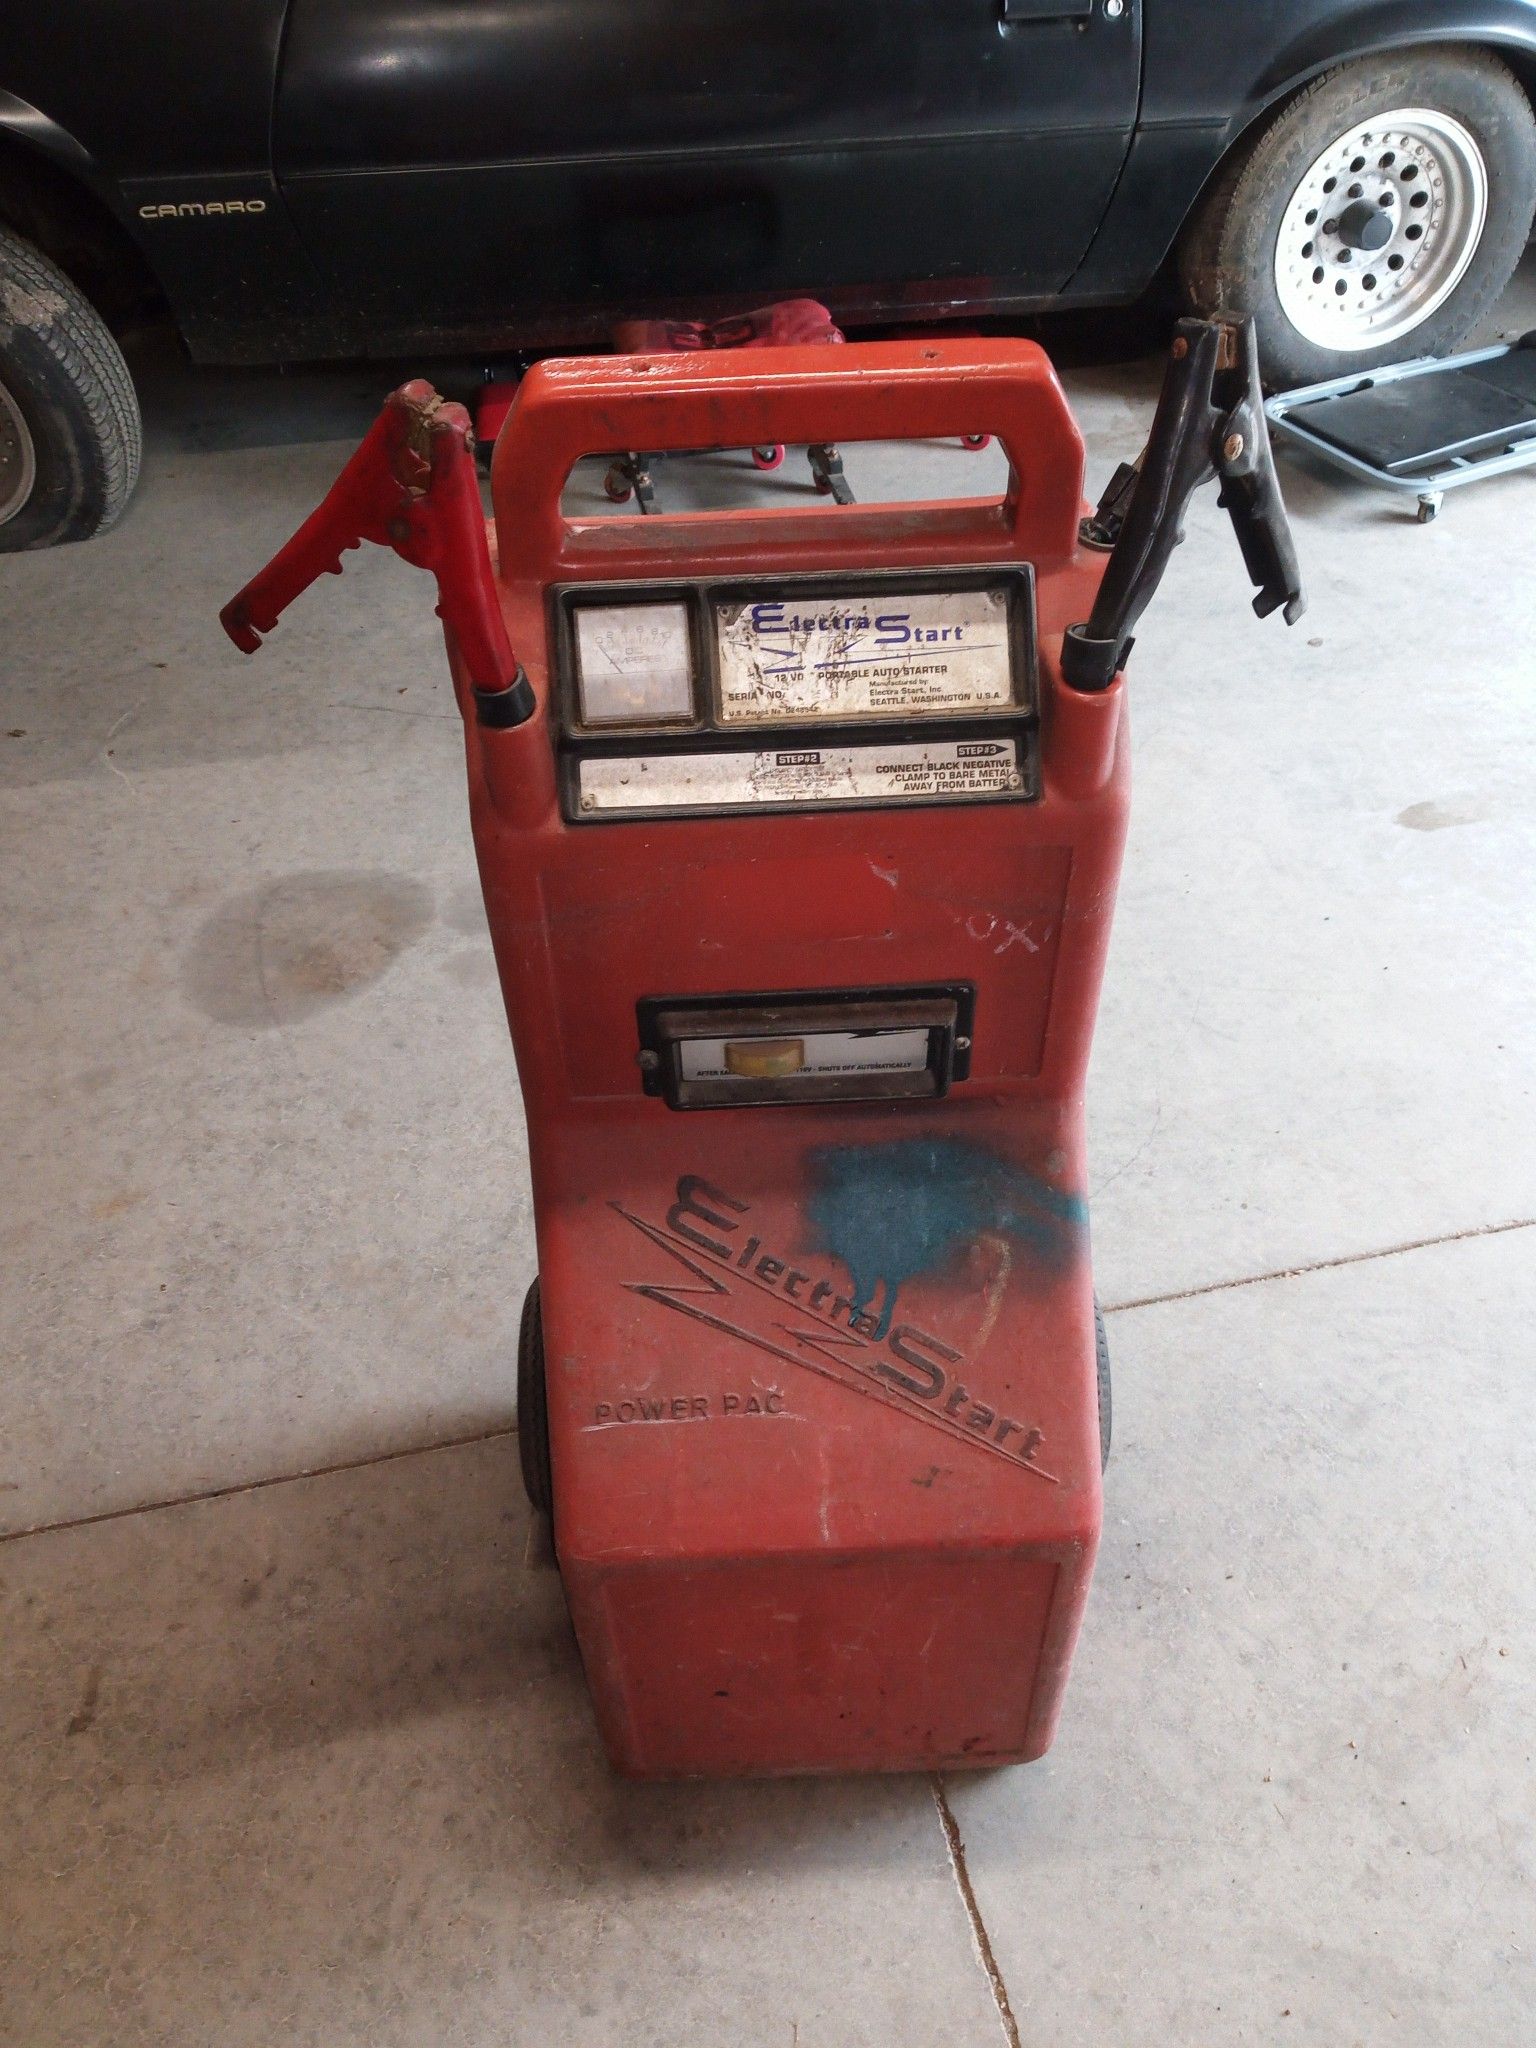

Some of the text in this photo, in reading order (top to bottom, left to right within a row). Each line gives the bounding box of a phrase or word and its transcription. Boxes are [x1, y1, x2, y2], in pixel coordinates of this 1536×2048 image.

[139, 200, 266, 219] CAMARO
[751, 604, 963, 644] Electra Start
[774, 674, 786, 683] 12
[818, 669, 870, 681] PORTABLE
[873, 668, 900, 678] AUTO
[903, 664, 948, 676] STARTER
[869, 688, 899, 697] Electra
[911, 692, 971, 704] WASHINGTON
[958, 745, 998, 756] STEP#3
[779, 754, 818, 764] STEP#2
[876, 758, 1012, 774] CONNECT BLACK NEGATIVE
[895, 773, 930, 782] CLAMP
[933, 772, 946, 780] TO
[949, 770, 976, 779] BARE
[903, 777, 1007, 791] AWAY FROM BATTER
[665, 1174, 1048, 1462] Electra Start
[594, 1393, 784, 1424] POWER PAC
